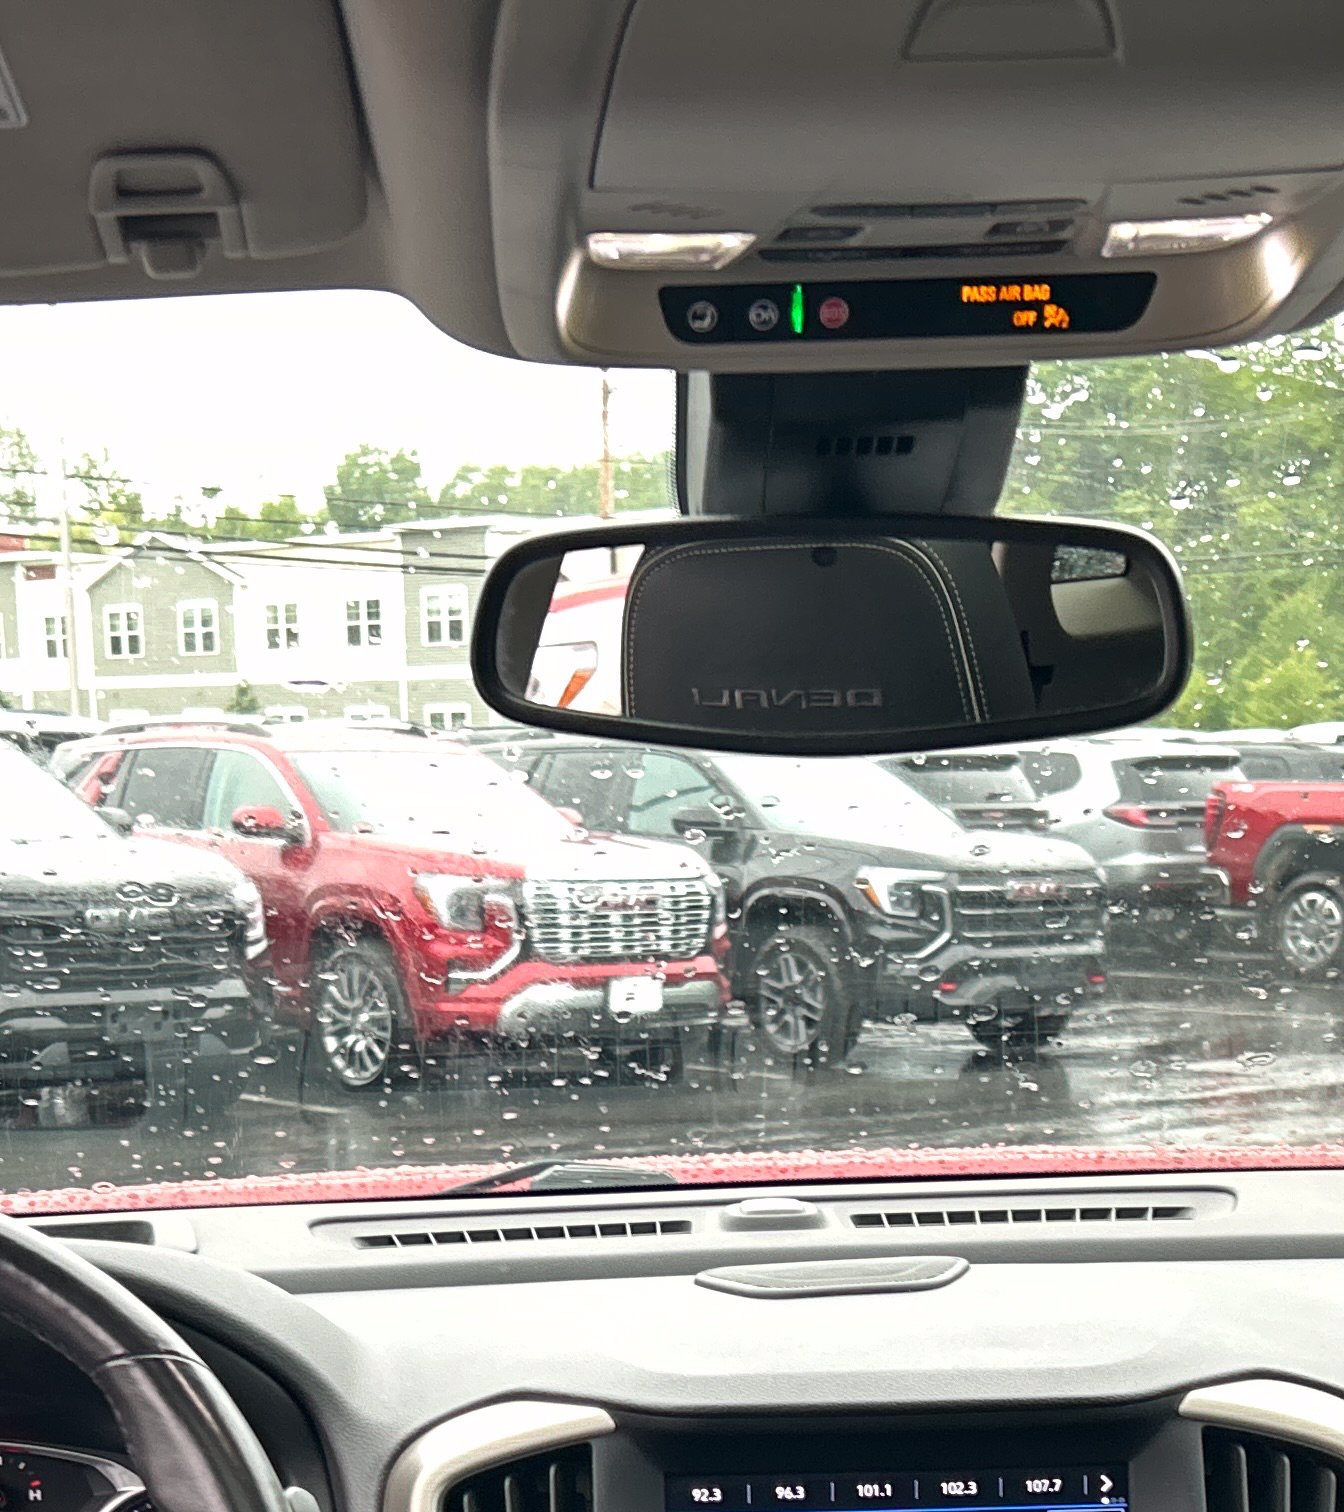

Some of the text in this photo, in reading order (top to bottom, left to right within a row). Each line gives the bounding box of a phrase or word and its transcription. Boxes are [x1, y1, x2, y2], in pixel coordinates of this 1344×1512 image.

[961, 283, 1051, 302] PASS AIR BAG
[1013, 309, 1037, 327] OFF
[28, 1489, 43, 1502] H
[691, 1479, 1062, 1502] 92.3 96.3 101.1 102.3 107.7
